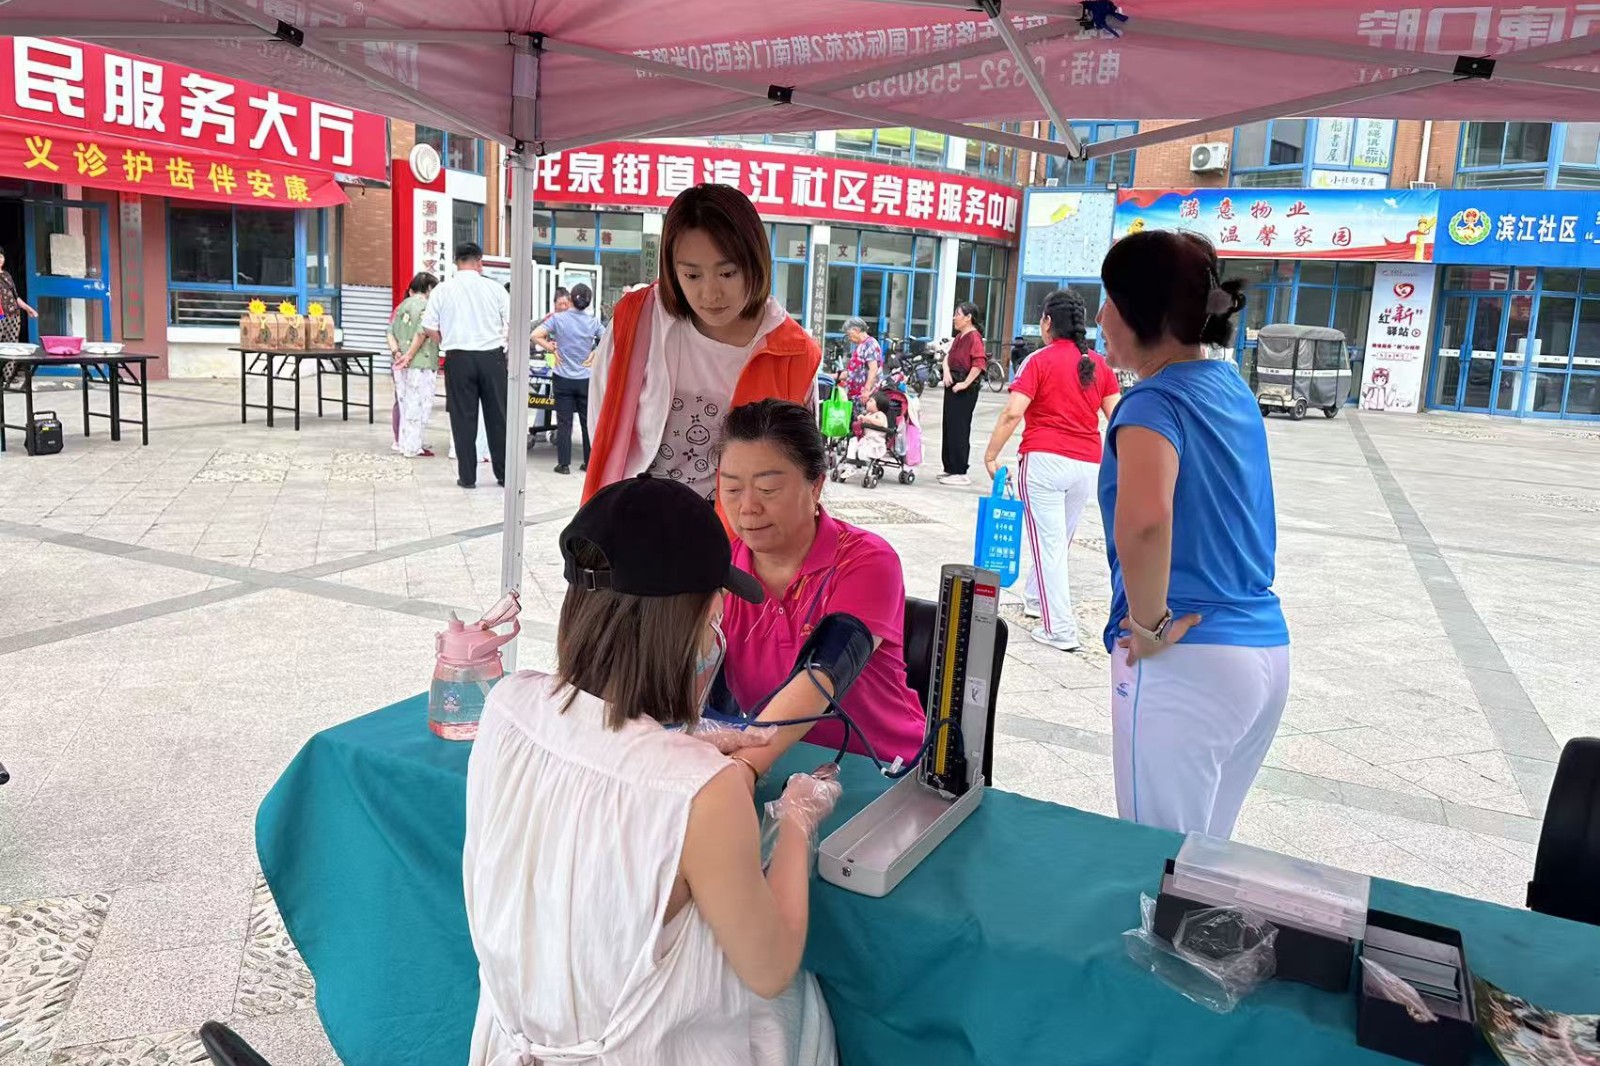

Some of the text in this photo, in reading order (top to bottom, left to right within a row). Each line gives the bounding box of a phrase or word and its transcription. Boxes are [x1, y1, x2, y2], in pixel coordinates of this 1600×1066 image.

[13, 36, 354, 167] 民服务大厅
[24, 135, 312, 202] 义诊护齿伴安康
[1180, 197, 1309, 220] 满意物业
[1219, 224, 1352, 247] 温馨家园
